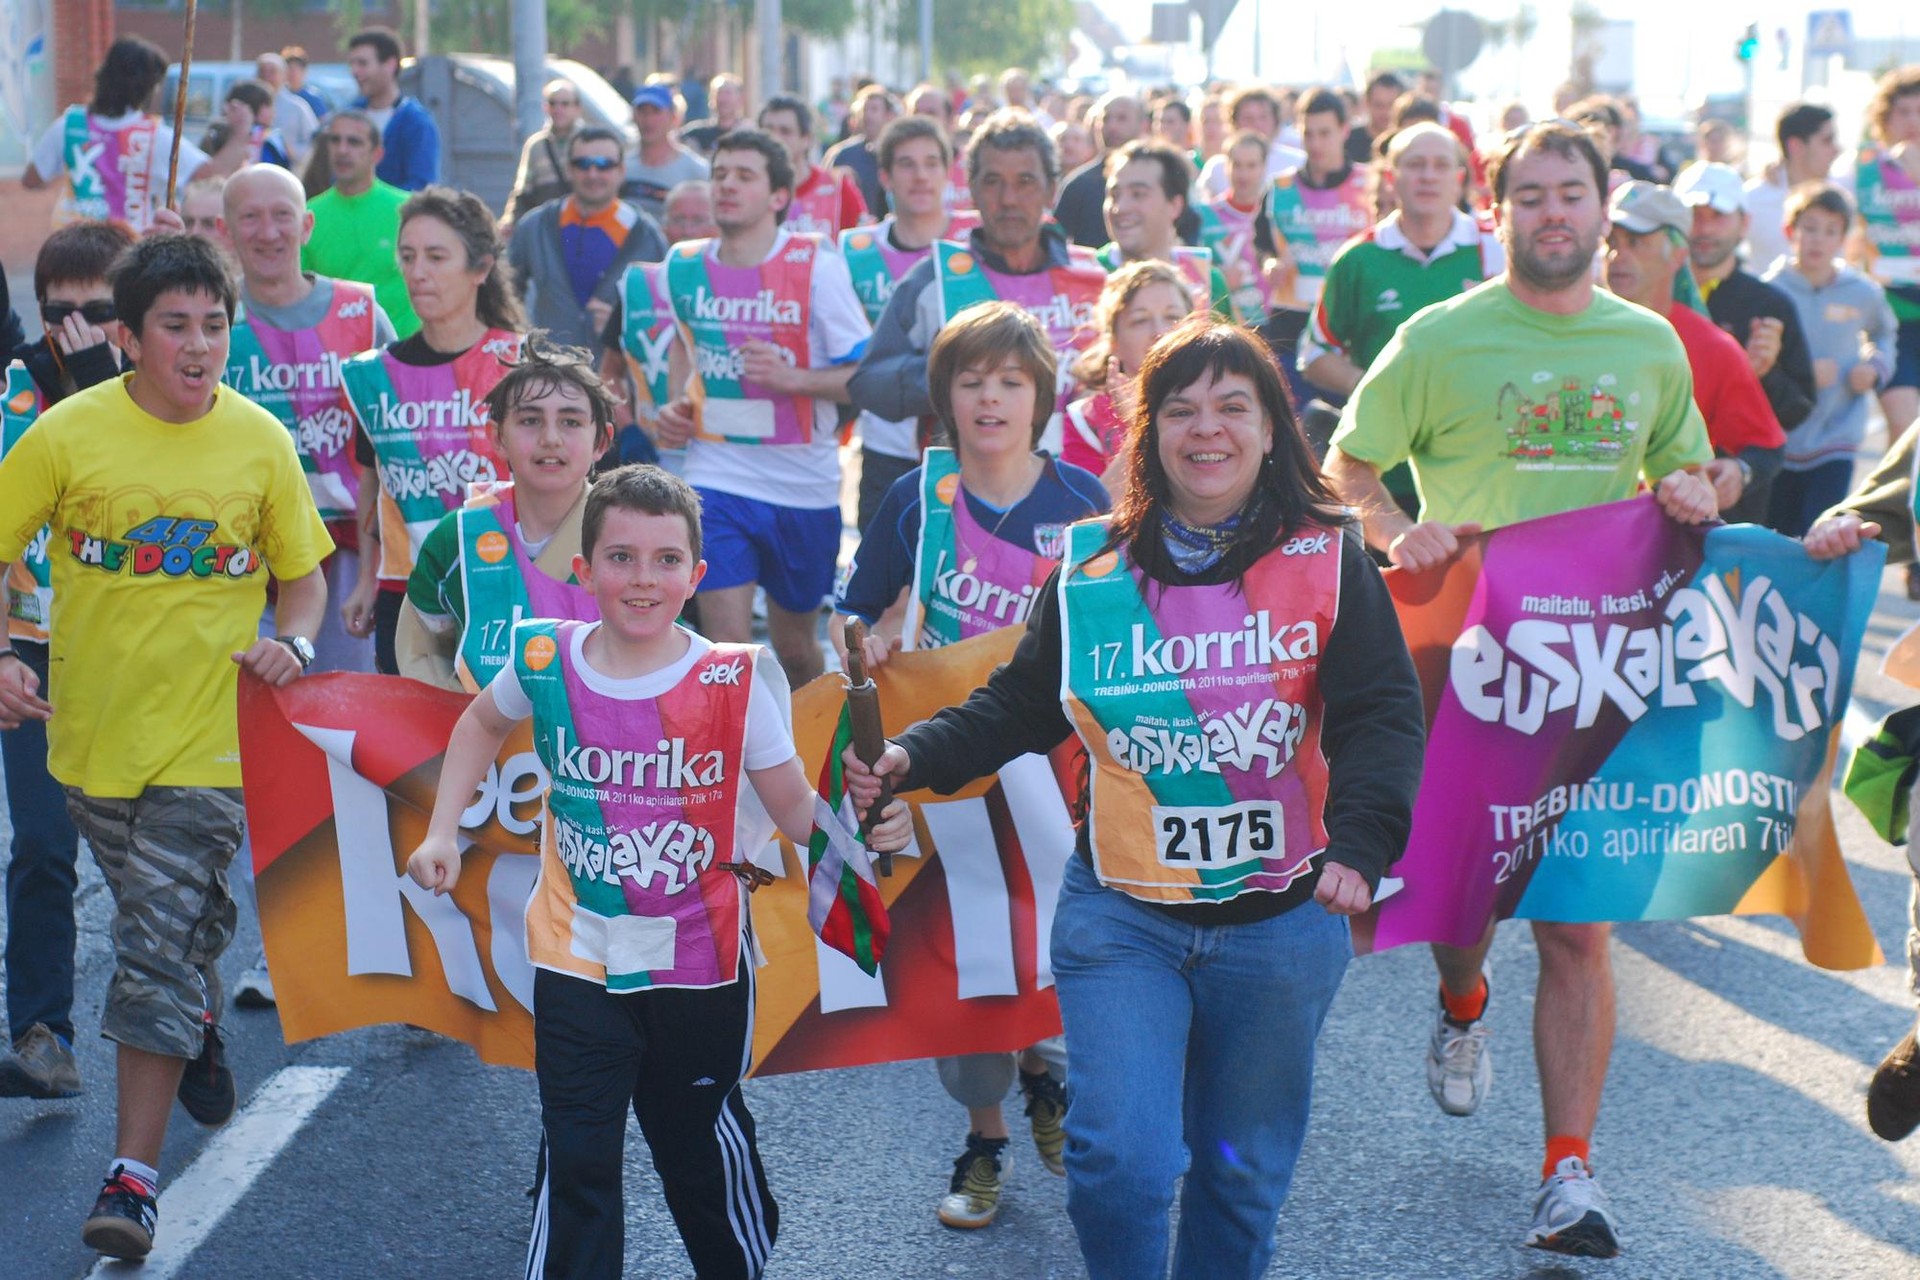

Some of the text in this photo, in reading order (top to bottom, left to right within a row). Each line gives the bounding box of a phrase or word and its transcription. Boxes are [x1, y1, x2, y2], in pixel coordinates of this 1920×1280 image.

[695, 286, 801, 325] korrika
[68, 527, 129, 573] THE
[123, 514, 219, 548] 46
[1282, 532, 1328, 556] aek
[1521, 568, 1686, 618] maitatu, ikasi, ari...
[480, 619, 507, 651] 17.
[1087, 610, 1319, 681] 17. korrika
[699, 656, 745, 687] aek
[1094, 677, 1196, 697] TREBIÑU-DONOSTIA
[1198, 676, 1234, 689] 2011ko
[1235, 670, 1280, 687] apirilaren
[1135, 714, 1171, 728] maitatu,
[1172, 715, 1197, 728] ikasi,
[555, 725, 726, 790] korrika
[646, 793, 689, 808] apirilaren
[1489, 768, 1798, 842] TREBIÑU-DONOSTI
[1162, 810, 1275, 862] 2175
[1491, 815, 1792, 885] 2011ko apirilaren 7ti
